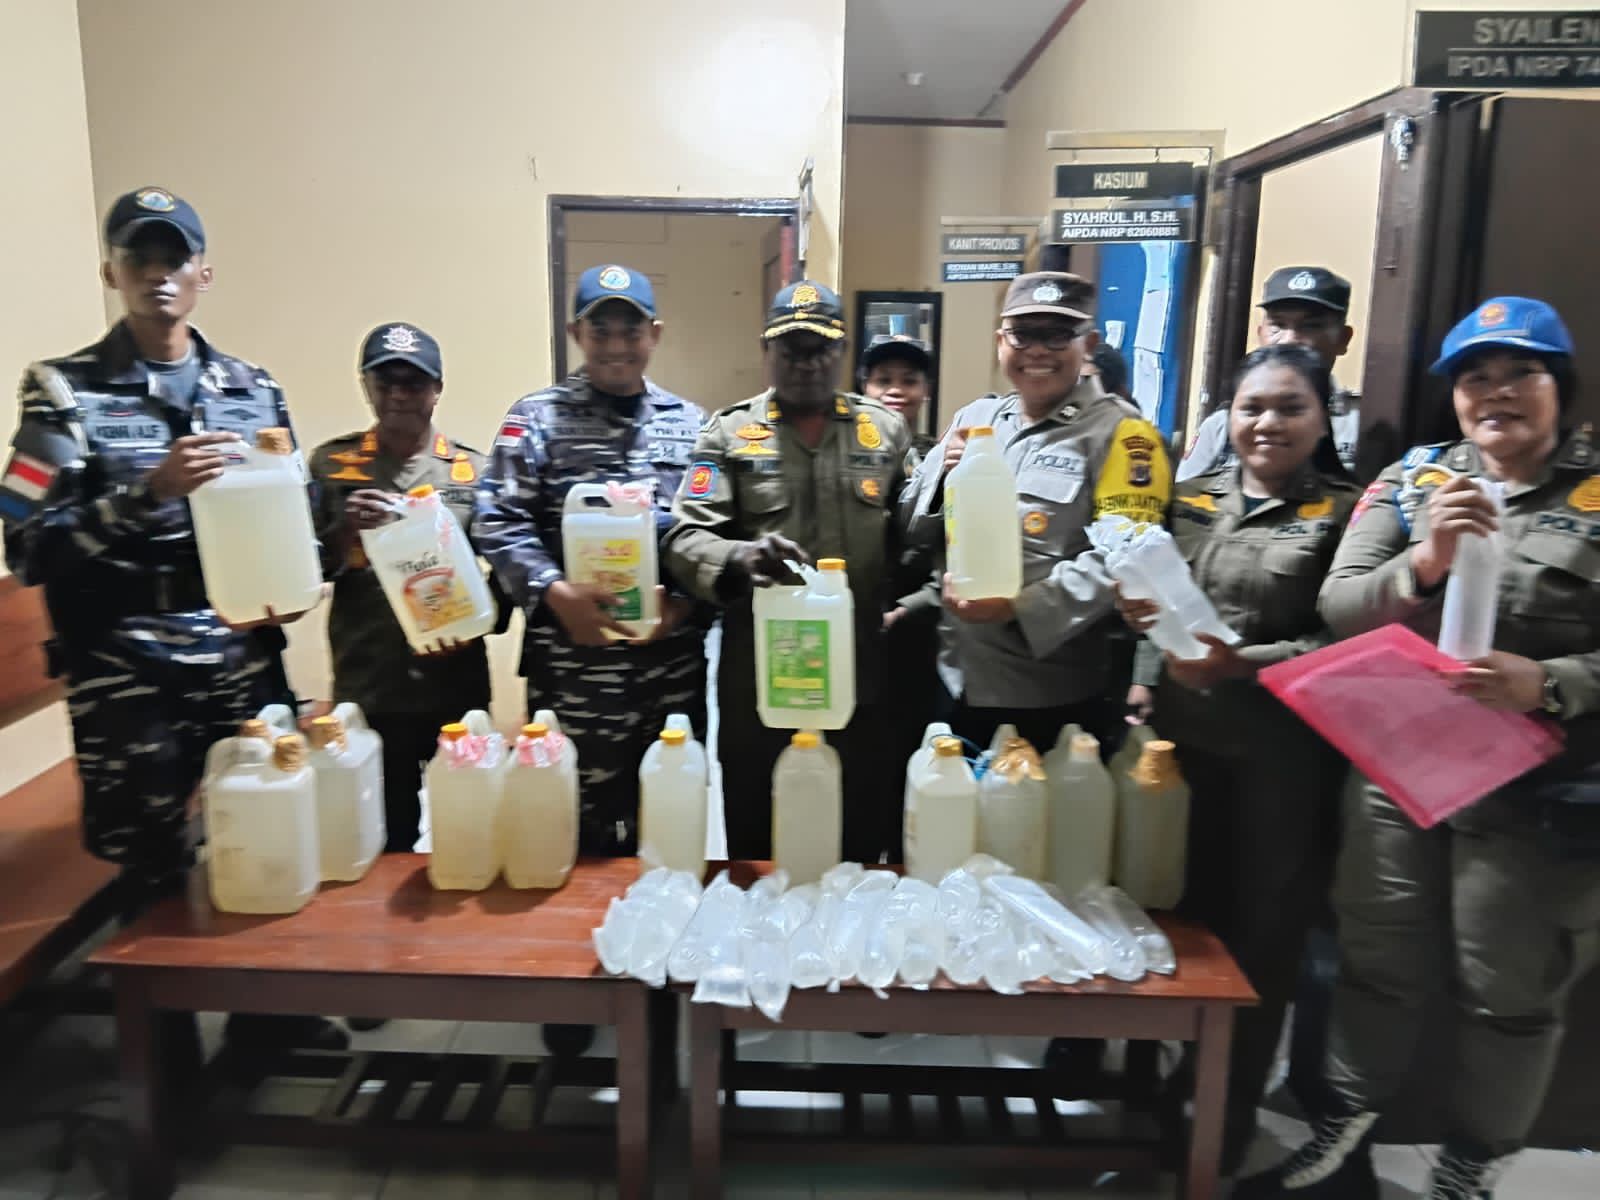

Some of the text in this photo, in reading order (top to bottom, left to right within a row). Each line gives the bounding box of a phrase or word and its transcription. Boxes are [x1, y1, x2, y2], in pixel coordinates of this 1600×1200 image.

[1093, 171, 1148, 189] KASIUM
[1062, 227, 1099, 239] AIPDA
[1100, 227, 1126, 238] NRP
